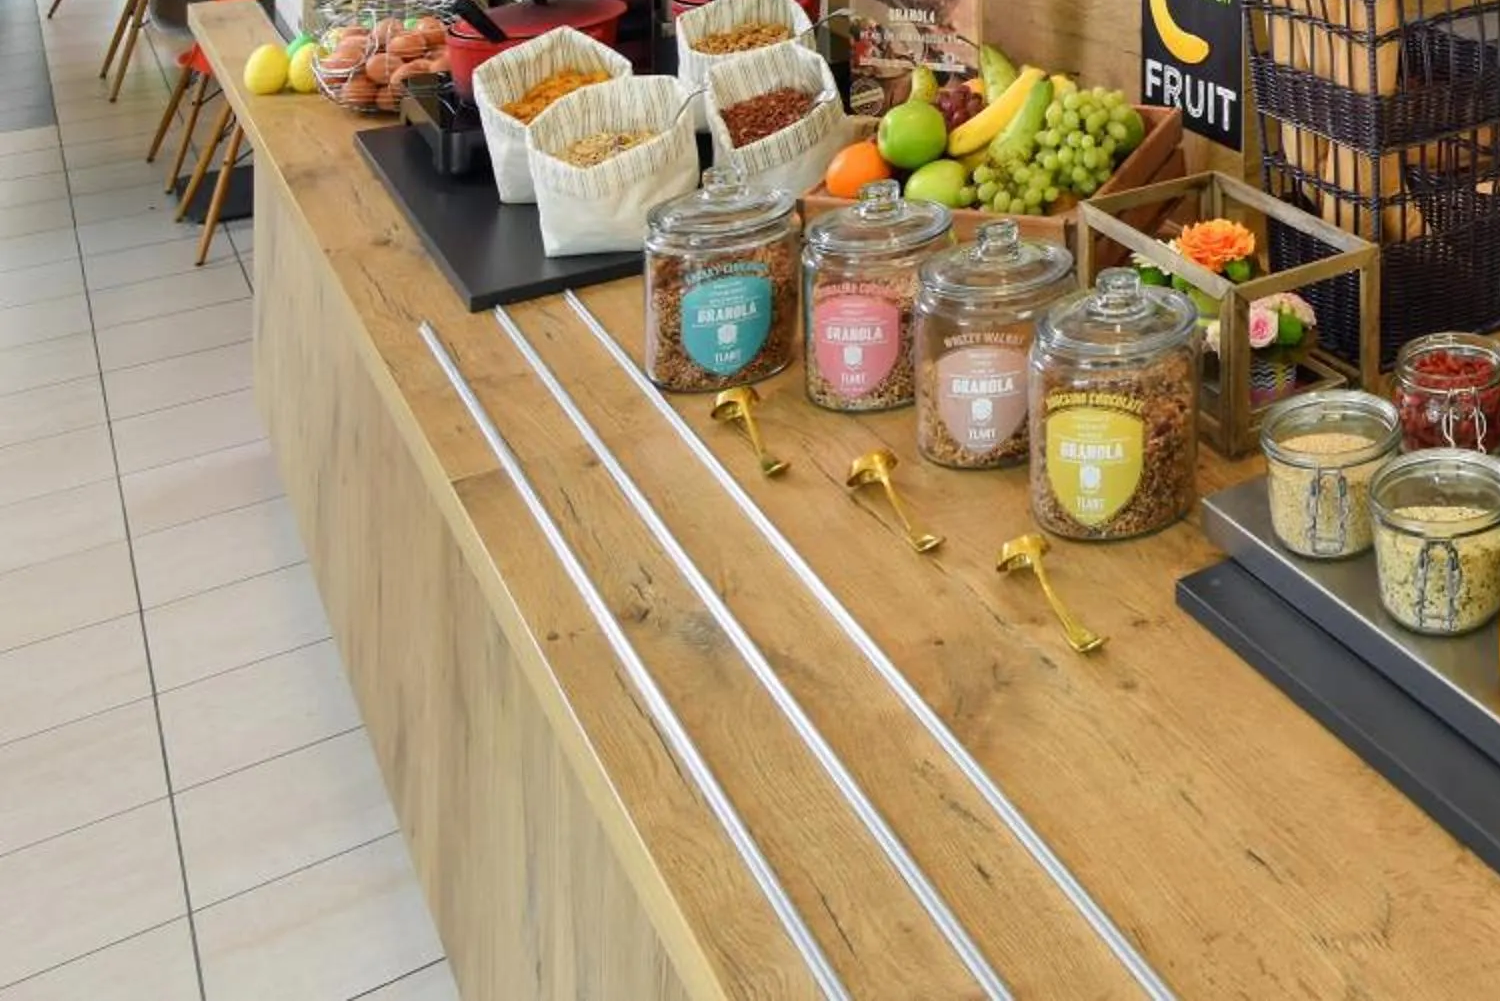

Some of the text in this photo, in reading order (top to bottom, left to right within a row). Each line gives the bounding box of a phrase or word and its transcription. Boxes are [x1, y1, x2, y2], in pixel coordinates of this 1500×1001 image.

[1144, 58, 1237, 132] FRUIT
[697, 301, 757, 323] GRANOLA
[826, 326, 884, 342] GRANOLA
[951, 378, 1014, 394] GRANOLA
[1059, 440, 1124, 460] GRANOLA
